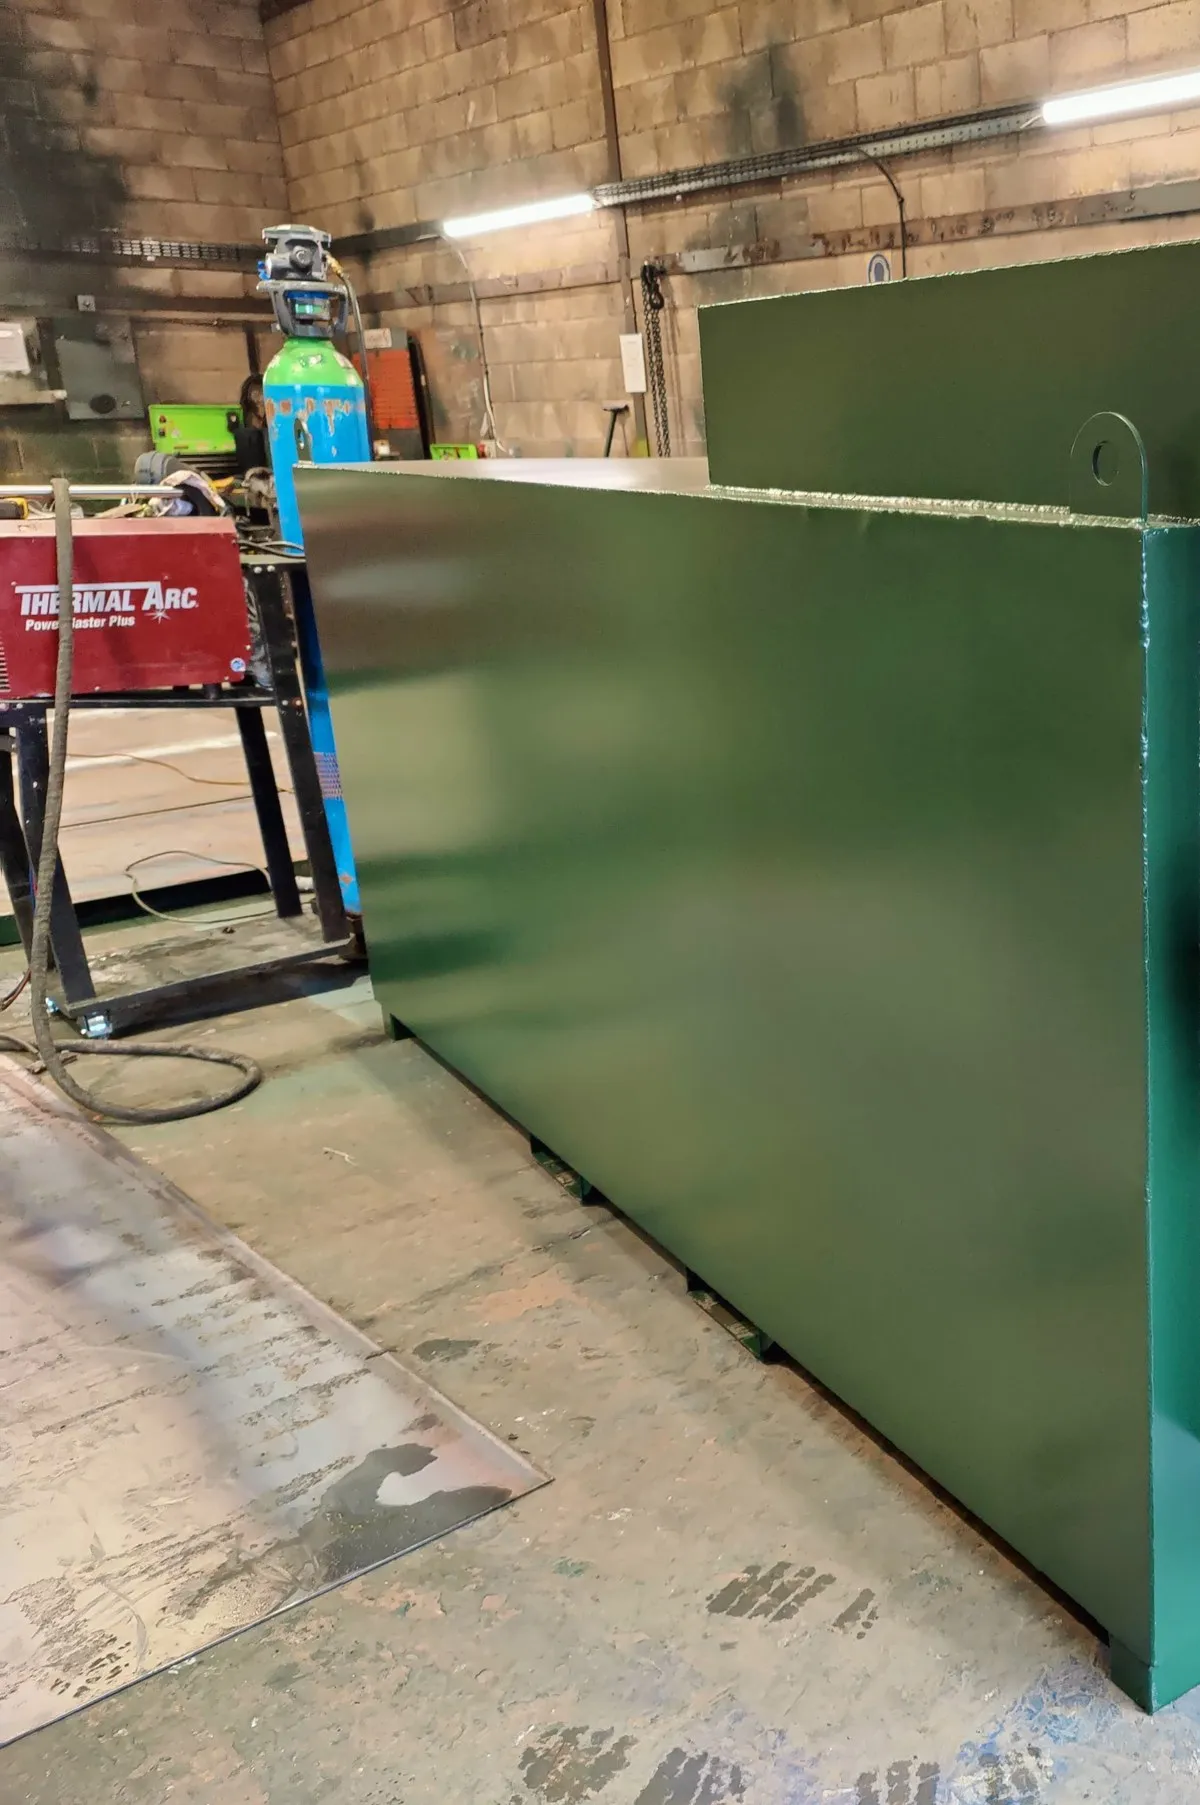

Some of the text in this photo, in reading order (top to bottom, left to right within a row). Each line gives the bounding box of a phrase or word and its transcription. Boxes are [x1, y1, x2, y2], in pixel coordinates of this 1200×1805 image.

[142, 581, 198, 610] ARC
[25, 615, 135, 631] Poweaster Plus
